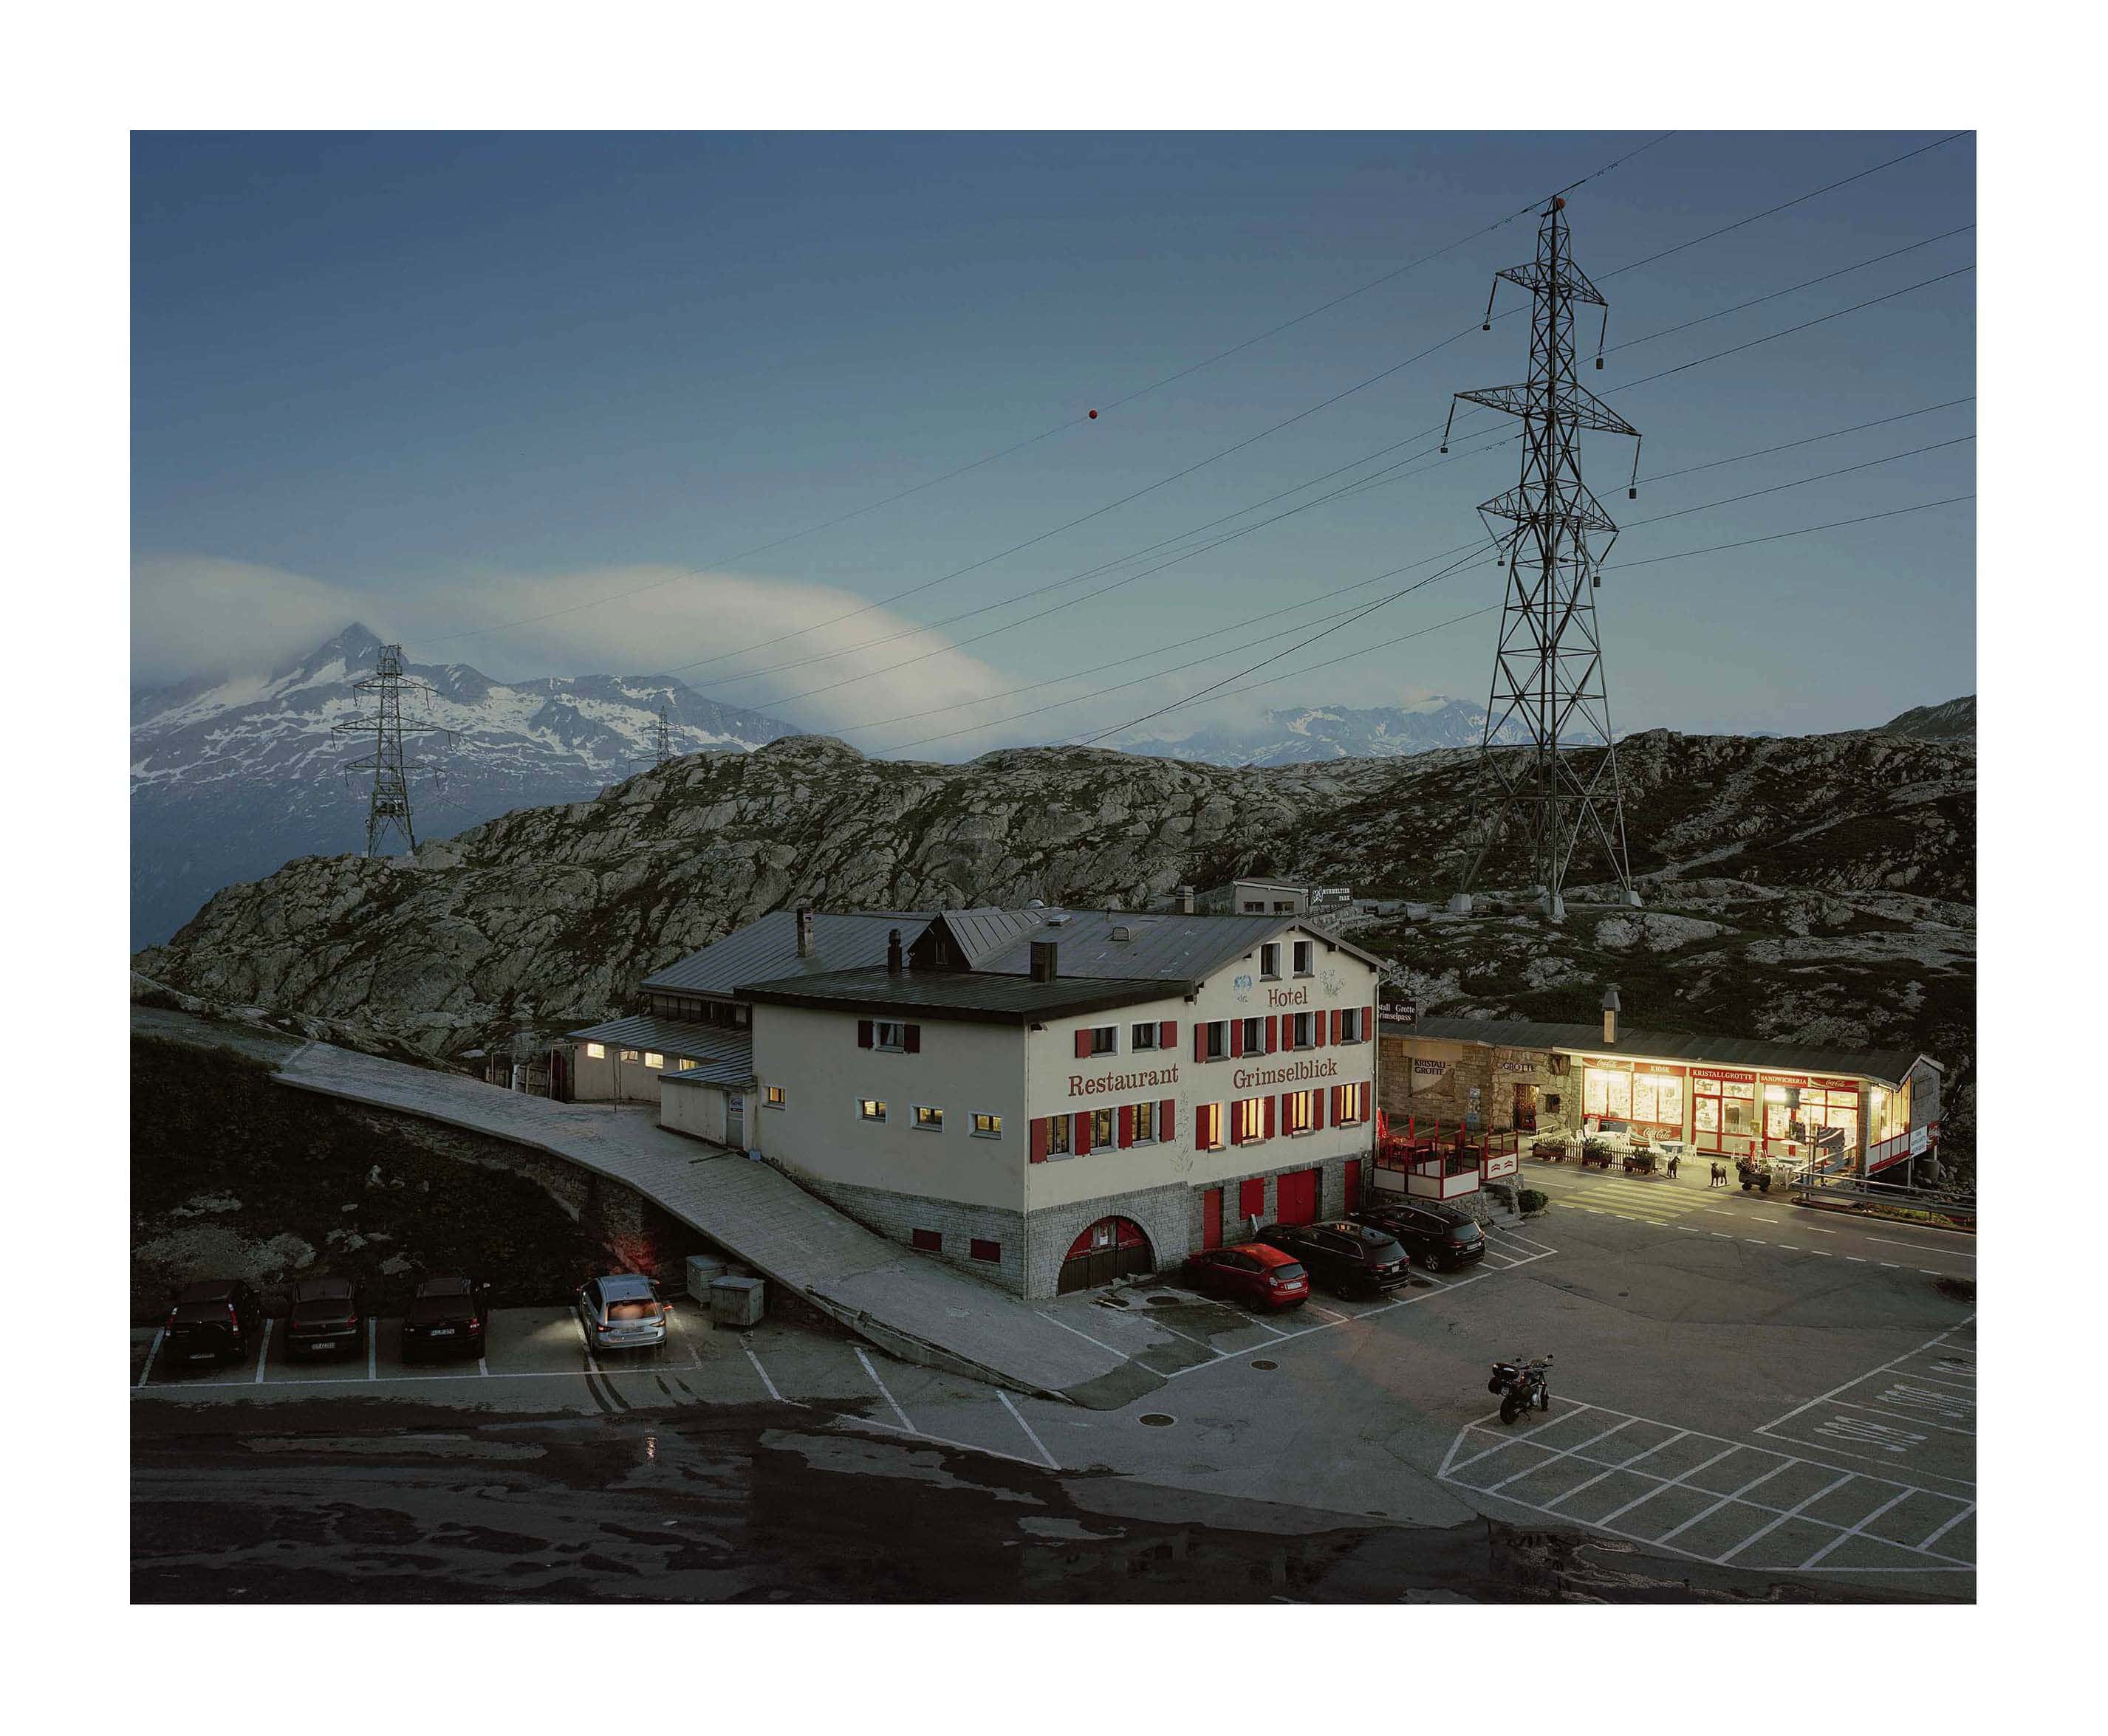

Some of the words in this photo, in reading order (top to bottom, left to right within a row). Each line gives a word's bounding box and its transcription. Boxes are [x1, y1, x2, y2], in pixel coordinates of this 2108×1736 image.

[1267, 986, 1308, 1007] Hotel
[1395, 1004, 1416, 1014] Grotte
[1068, 1063, 1179, 1097] Restaurant
[1233, 1058, 1338, 1089] Grimselblick
[1692, 1069, 1753, 1080] KRISTALLGROTTE
[1760, 1075, 1807, 1085] SANDWICHERIA
